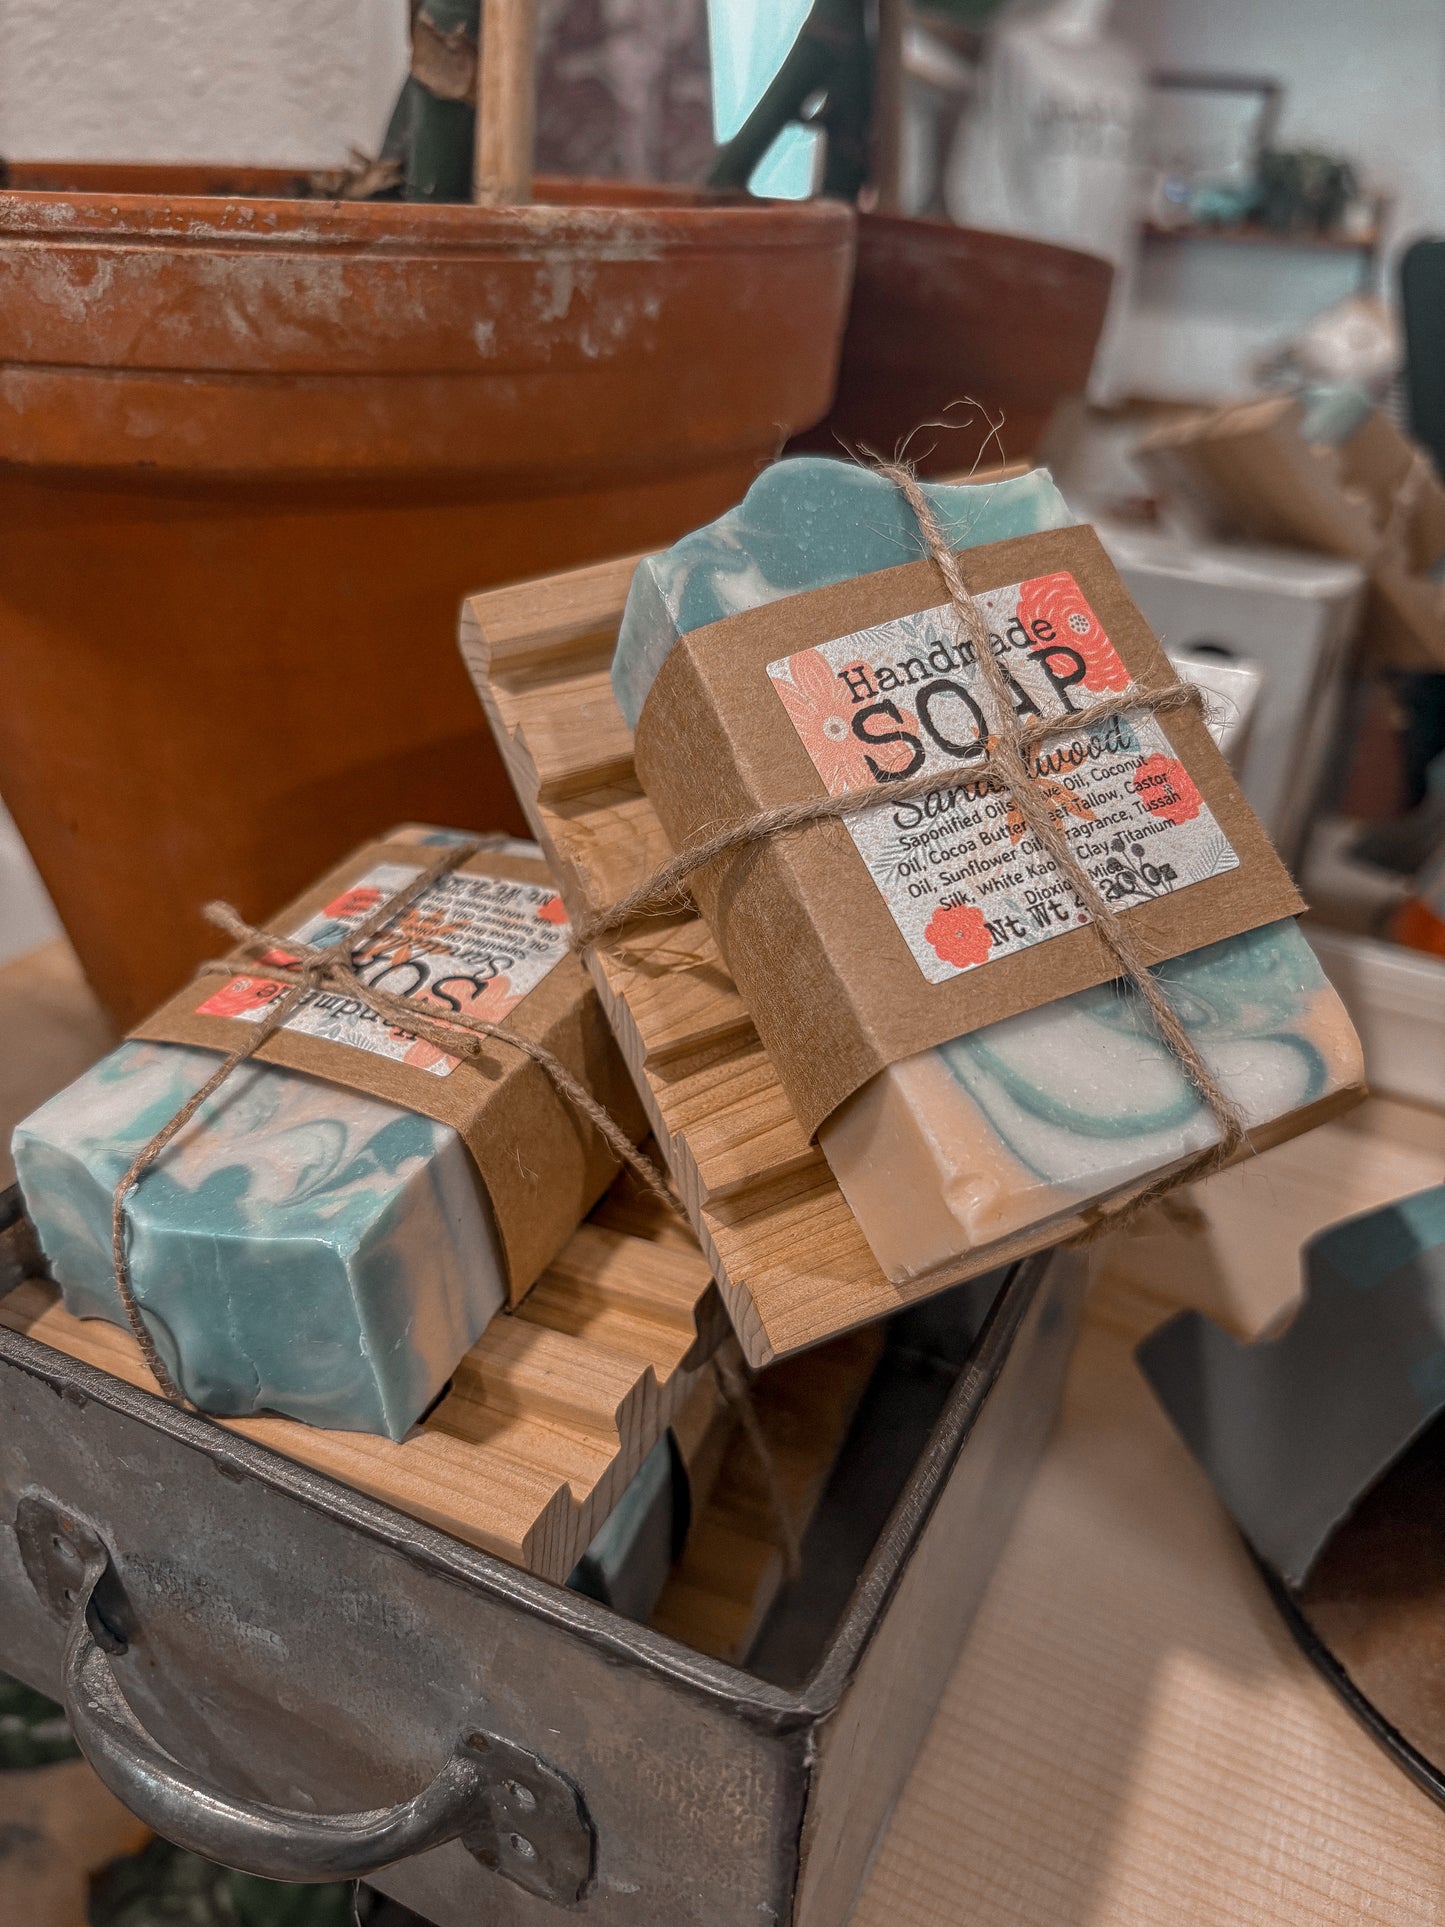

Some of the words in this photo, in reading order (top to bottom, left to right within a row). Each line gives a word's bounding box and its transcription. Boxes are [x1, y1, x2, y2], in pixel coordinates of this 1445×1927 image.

[838, 618, 1057, 703] Handmade
[897, 856, 927, 877] Oil,
[929, 841, 977, 865] Cocoa
[1047, 806, 1070, 822] eef
[1072, 790, 1124, 813] Tallow,
[1124, 772, 1169, 795] Castor
[899, 810, 983, 851] Saponified
[985, 801, 1016, 820] Oils
[1064, 774, 1090, 791] Oil,
[1091, 754, 1148, 783] Coconut
[908, 878, 938, 899] Oil,
[939, 849, 1018, 887] Sunflower
[1060, 808, 1134, 840] ragrance,
[1132, 791, 1182, 815] Tussah
[939, 891, 976, 912] Silk,
[975, 873, 1024, 897] White
[1114, 817, 1177, 846] Titanium
[984, 915, 1026, 947] Nt
[1026, 900, 1070, 929] Wt
[1140, 861, 1178, 886] Oz
[1087, 858, 1124, 881] Mica
